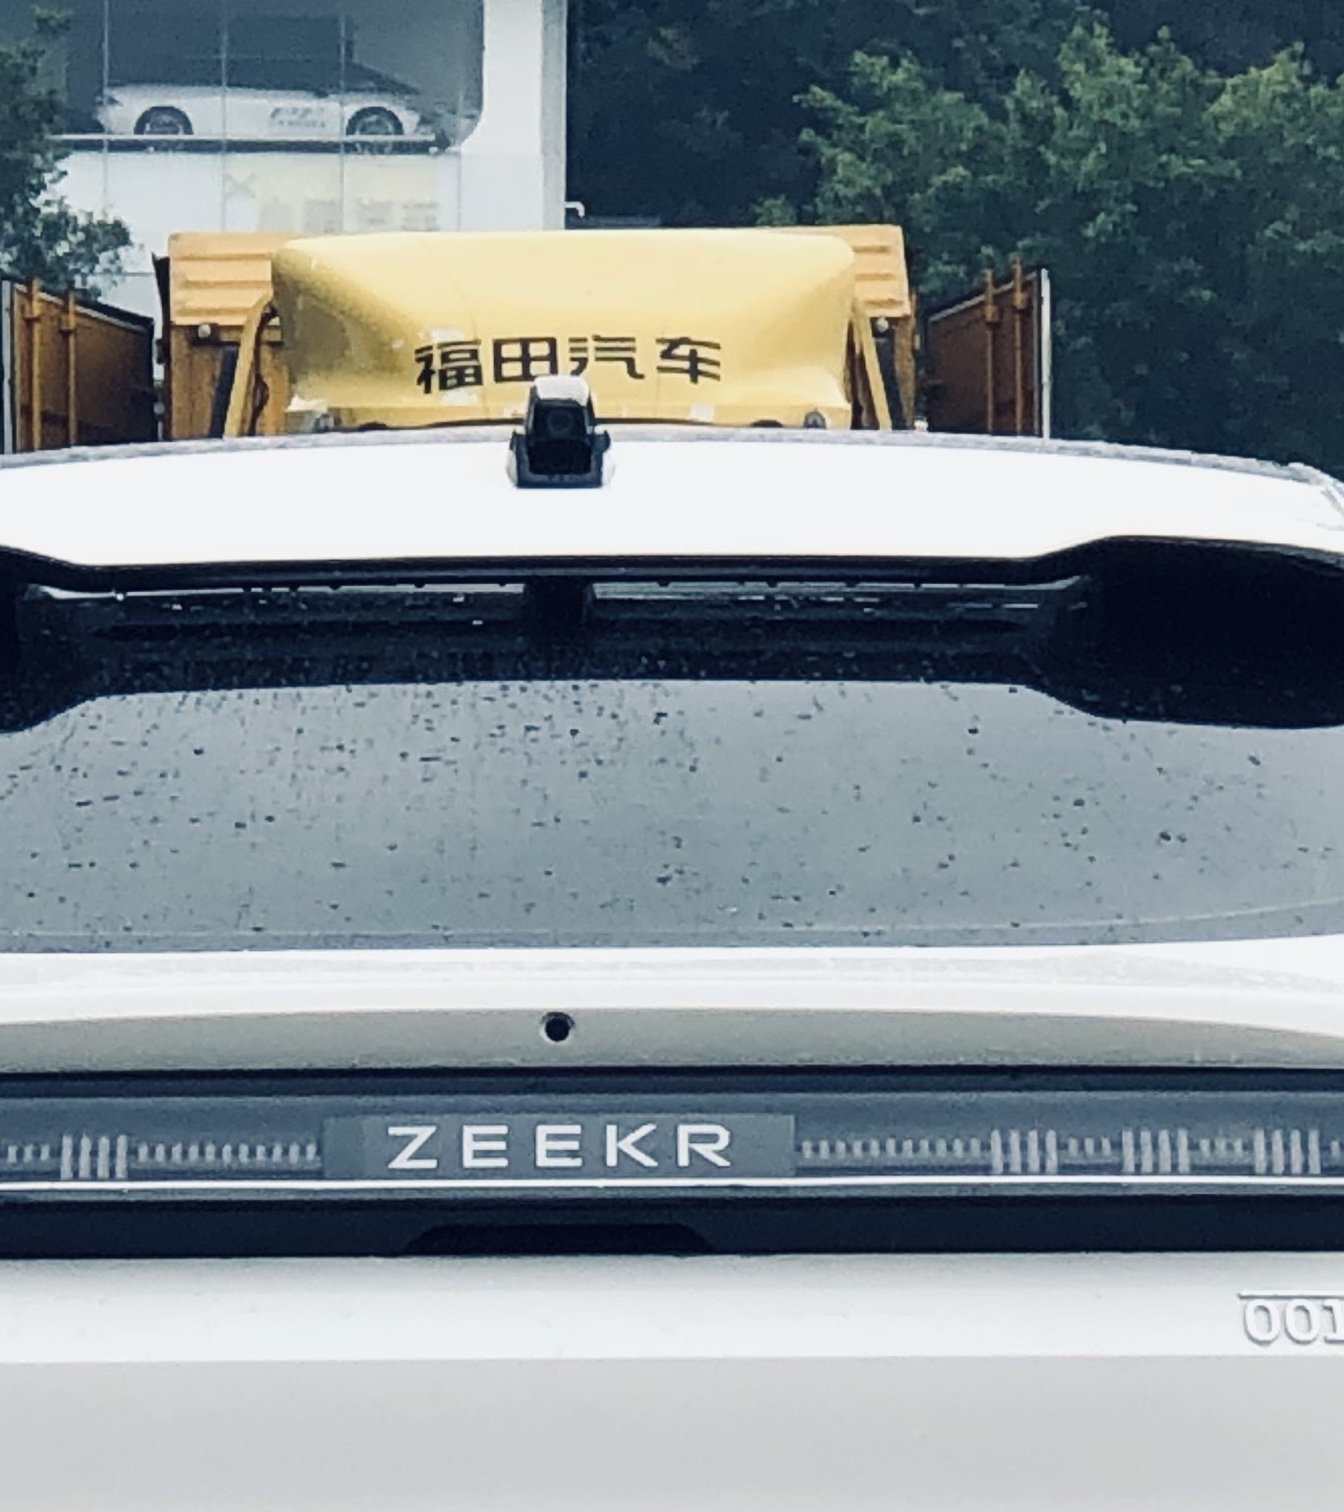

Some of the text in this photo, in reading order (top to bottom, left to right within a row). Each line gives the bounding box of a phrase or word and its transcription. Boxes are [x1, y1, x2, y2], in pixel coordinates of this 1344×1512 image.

[414, 334, 722, 394] 福田汽车
[387, 1122, 732, 1170] ZEEKR
